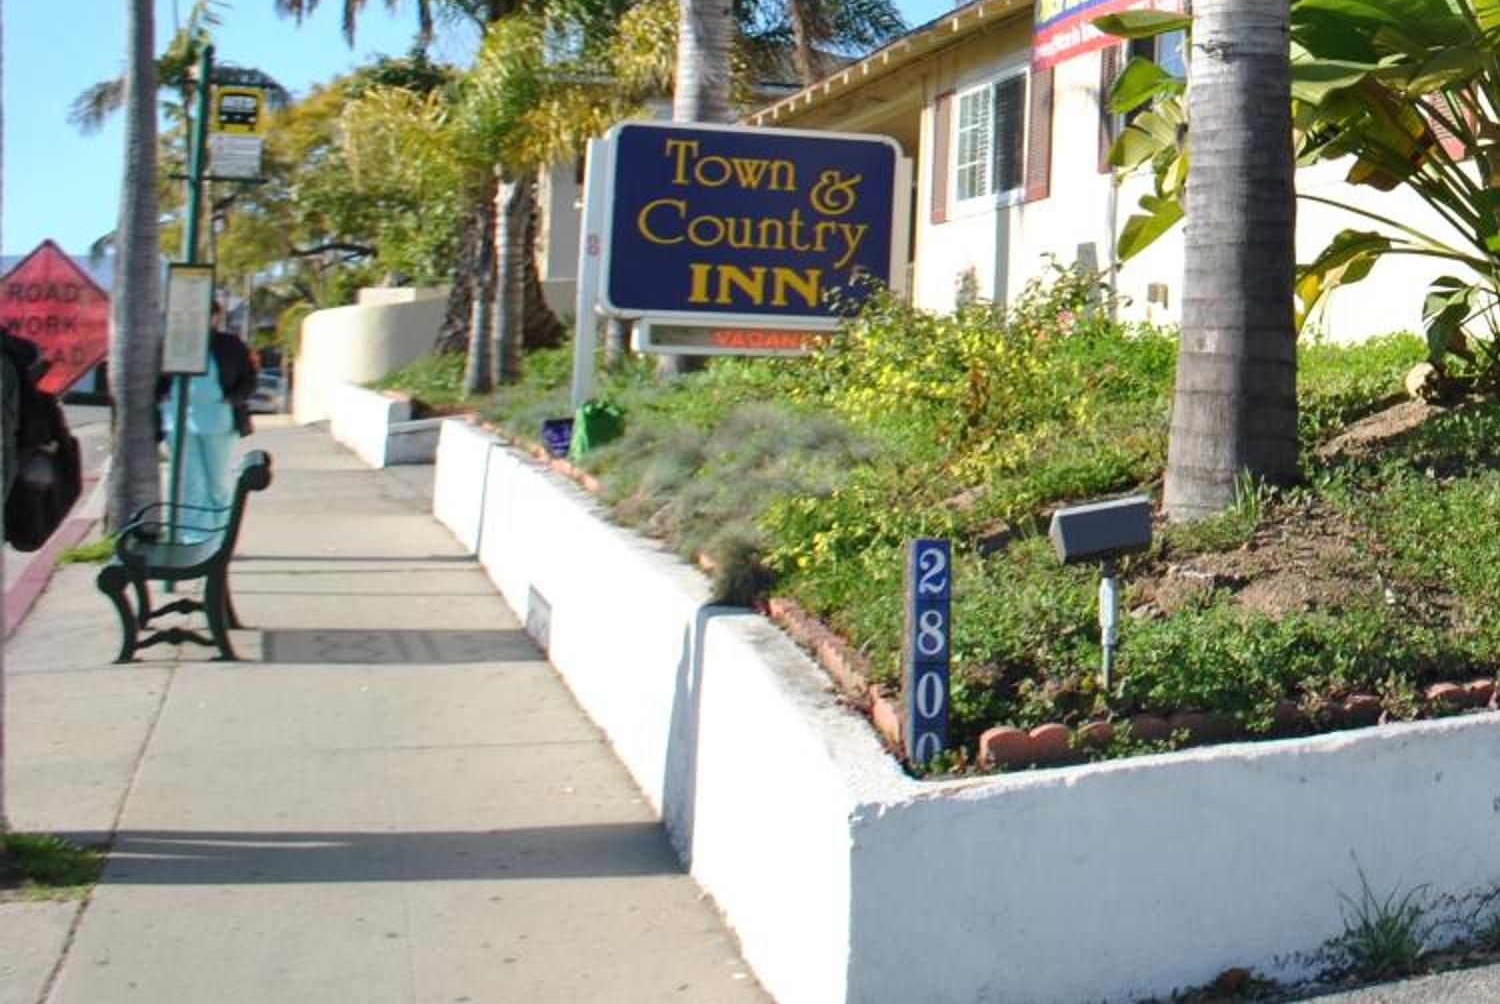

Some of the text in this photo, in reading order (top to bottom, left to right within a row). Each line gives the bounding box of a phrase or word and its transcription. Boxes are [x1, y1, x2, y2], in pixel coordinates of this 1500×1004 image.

[665, 138, 863, 216] Town &
[637, 198, 870, 270] Country
[10, 282, 79, 303] ROAD
[687, 263, 822, 308] INN
[4, 314, 78, 335] WORK
[714, 328, 832, 348] VACAN
[915, 548, 946, 763] 2800
